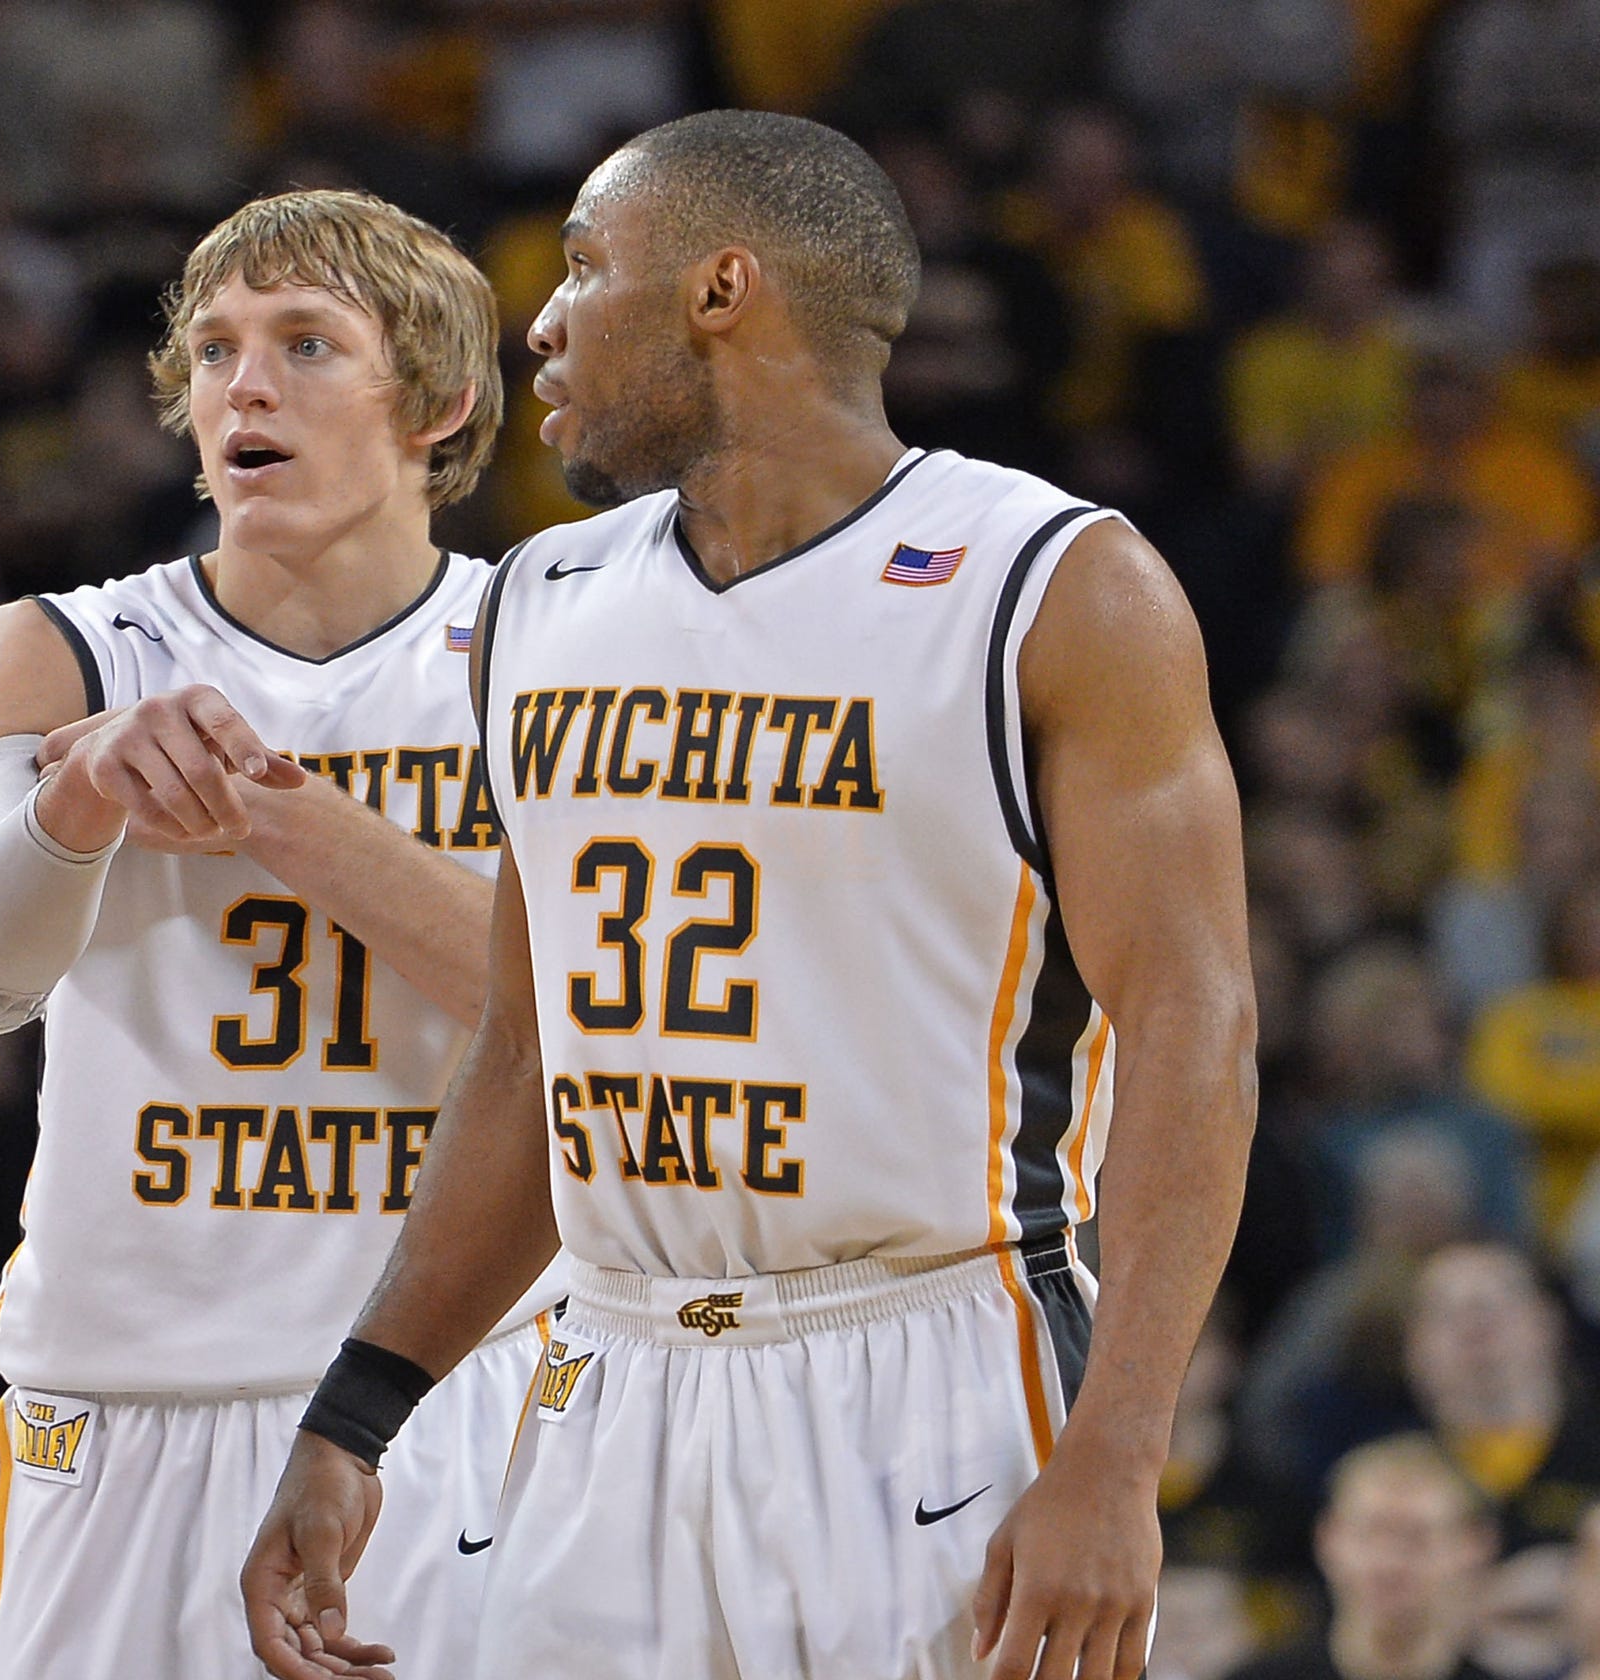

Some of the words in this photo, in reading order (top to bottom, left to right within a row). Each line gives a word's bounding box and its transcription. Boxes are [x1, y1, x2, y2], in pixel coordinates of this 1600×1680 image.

[511, 685, 886, 814] WICHITA
[210, 891, 379, 1072] 31
[567, 836, 761, 1043] 32
[131, 1100, 441, 1214] STATE
[551, 1071, 806, 1198] STATE
[26, 1401, 56, 1422] THE
